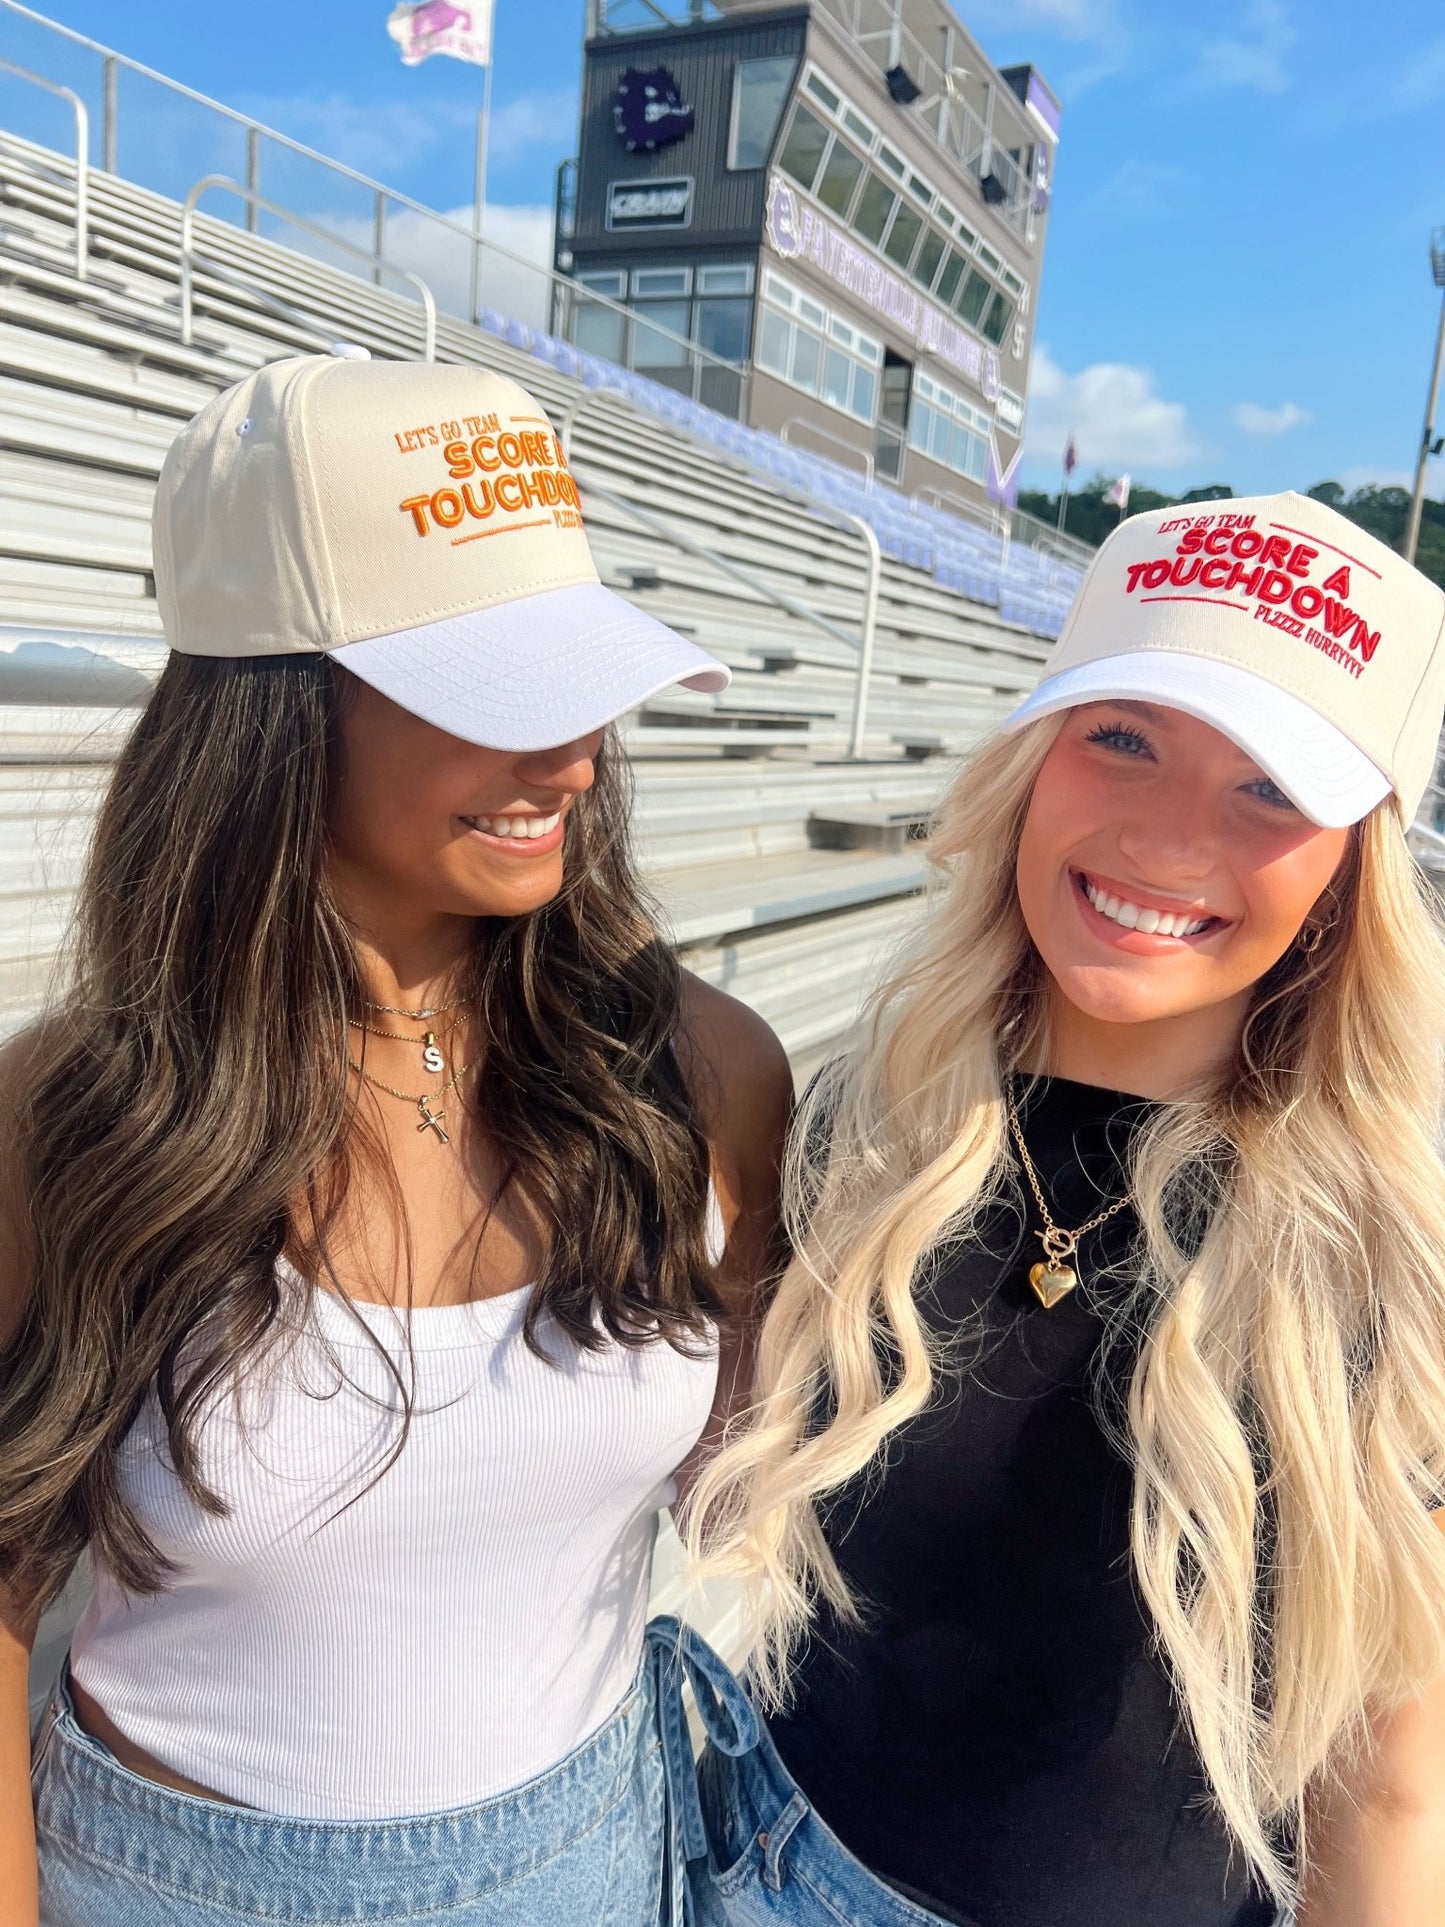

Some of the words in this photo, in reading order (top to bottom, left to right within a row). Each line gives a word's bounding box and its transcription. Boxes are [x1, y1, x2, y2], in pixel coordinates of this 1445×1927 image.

[394, 425, 439, 453] LET'S
[440, 420, 462, 441] GO
[462, 412, 501, 437] TEAM
[443, 431, 554, 479] SCORE
[1157, 516, 1195, 534] LET'S
[1194, 515, 1216, 528] GO
[1217, 514, 1257, 529] TEAM
[1176, 527, 1319, 578] SCORE
[1322, 565, 1351, 600] A
[1125, 556, 1381, 662] TOUCHDOWN
[424, 1046, 445, 1073] S
